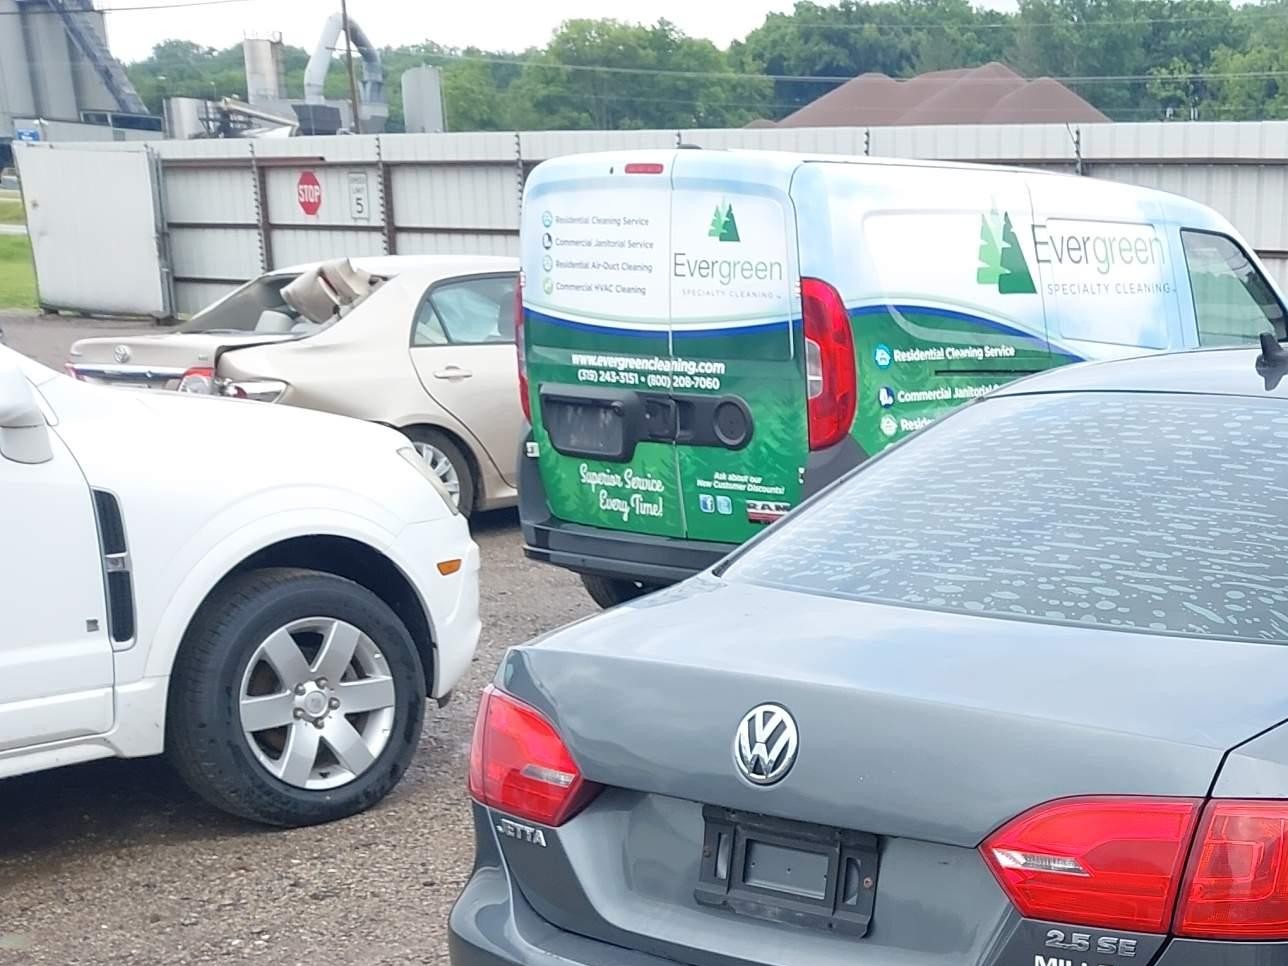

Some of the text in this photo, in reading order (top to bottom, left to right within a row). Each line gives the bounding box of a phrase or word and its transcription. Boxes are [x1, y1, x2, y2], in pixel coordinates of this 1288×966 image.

[299, 184, 320, 203] STOP
[355, 197, 363, 214] 5
[592, 216, 621, 226] Cleaning
[623, 217, 649, 226] Service
[555, 238, 592, 247] Commercial
[627, 240, 654, 249] Service
[1031, 224, 1165, 274] Evergreen
[591, 261, 620, 271] Air-Duct
[621, 262, 653, 274] Cleaning
[674, 252, 782, 285] Evergreen
[556, 282, 592, 292] Commercial
[615, 284, 646, 296] Cleaning
[682, 289, 725, 297] SPECIALTY
[729, 290, 773, 299] CLEANING
[1047, 282, 1170, 295] SPECIALTY CLEANING
[893, 344, 1016, 362] Residential Cleaning Service
[572, 354, 725, 375] www.evergreencleaning.com
[599, 370, 639, 385] 243-3151
[647, 375, 671, 388] (800)
[673, 376, 720, 390] 208-7060
[897, 387, 952, 403] Commercial
[580, 463, 664, 493] Superior Service
[697, 479, 713, 488] New
[713, 481, 747, 491] Customer
[599, 489, 663, 522] Every Time!
[747, 502, 791, 512] RAM
[1097, 936, 1137, 957] SE
